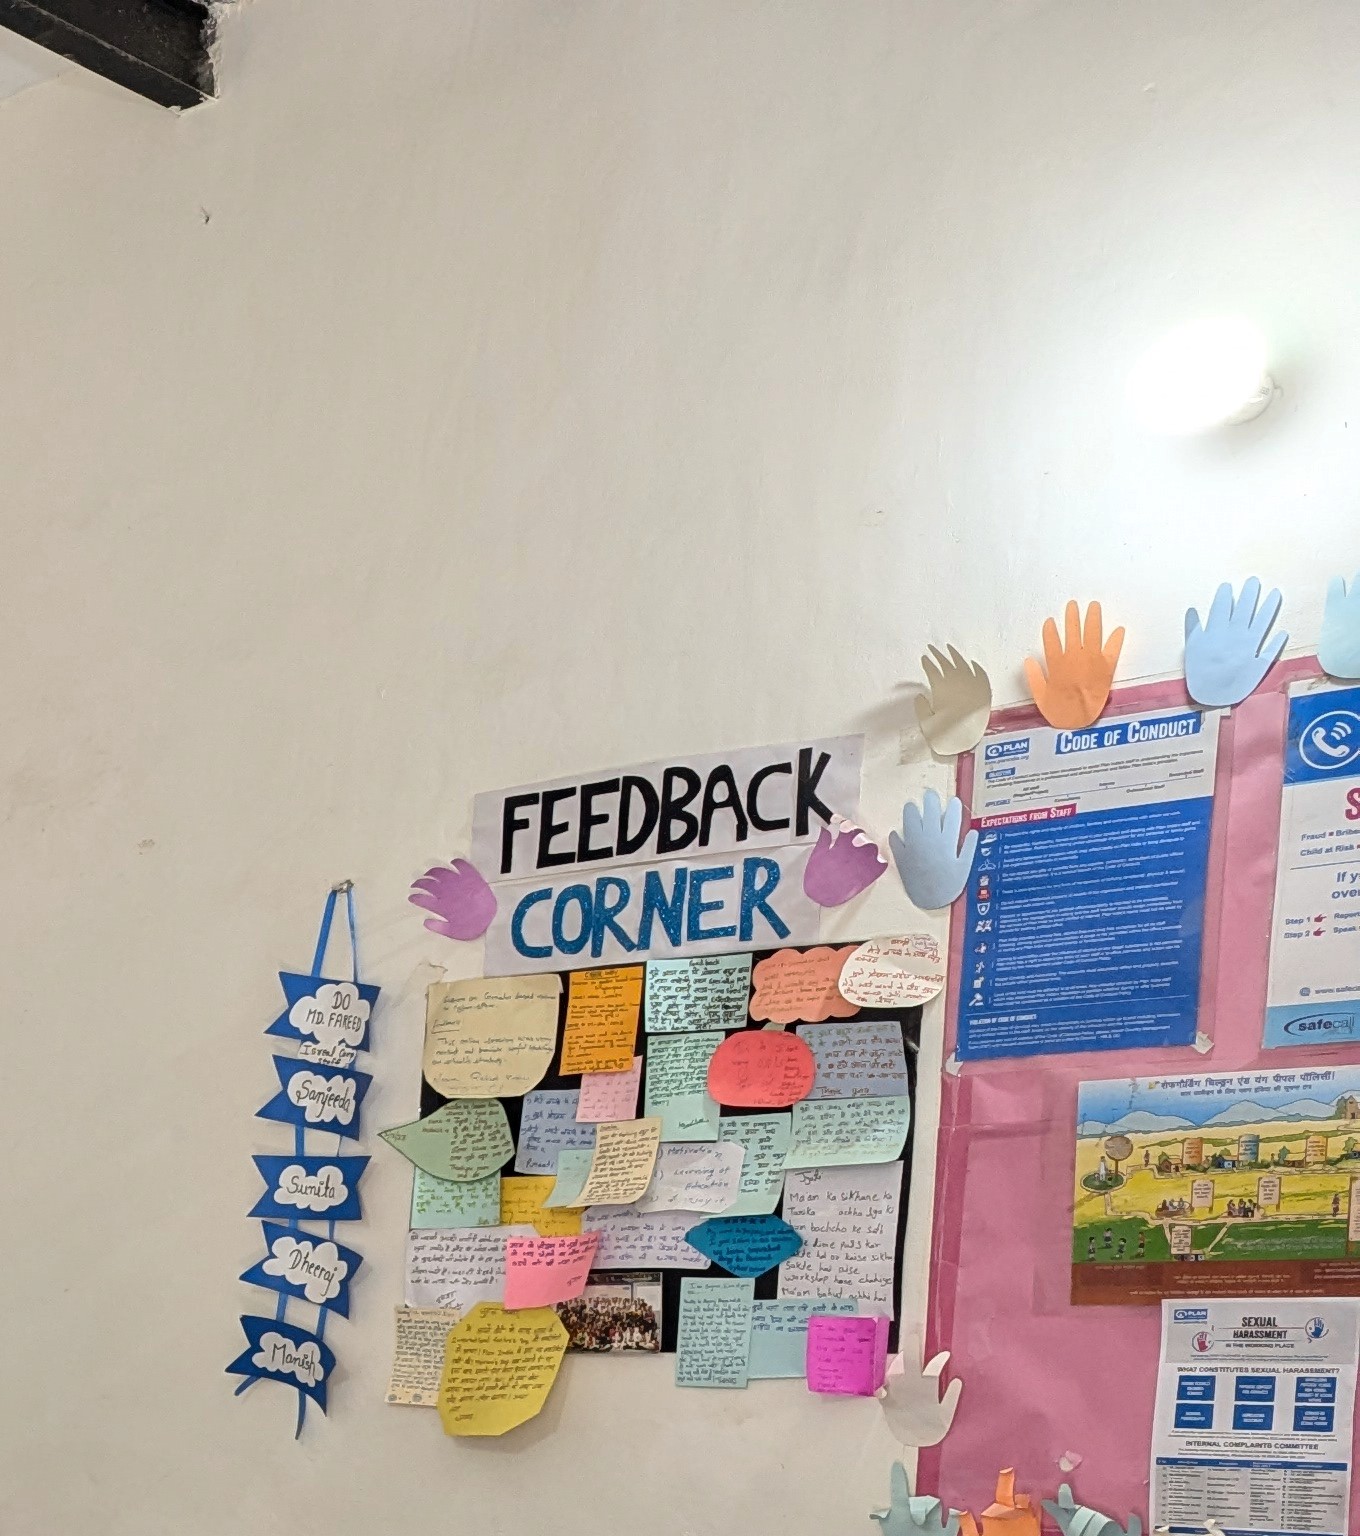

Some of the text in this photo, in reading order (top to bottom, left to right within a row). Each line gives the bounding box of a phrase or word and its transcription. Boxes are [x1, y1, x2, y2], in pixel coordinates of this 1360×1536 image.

[1003, 740, 1028, 752] PLAN
[1060, 718, 1197, 753] CODE OF CONDUCT
[500, 747, 837, 874] FEEDBACK
[1301, 832, 1326, 841] Fraud
[1300, 848, 1323, 857] Child
[1335, 844, 1354, 852] Risk
[511, 857, 791, 958] CORNER
[327, 1013, 362, 1032] FAREED
[296, 1079, 351, 1118] Sanjeeda
[286, 1174, 336, 1200] Sunita
[289, 1248, 335, 1298] Dheeraj
[1233, 1329, 1288, 1339] HARASSMENT
[1241, 1316, 1278, 1328] SEXUAL
[272, 1341, 316, 1380] Manish
